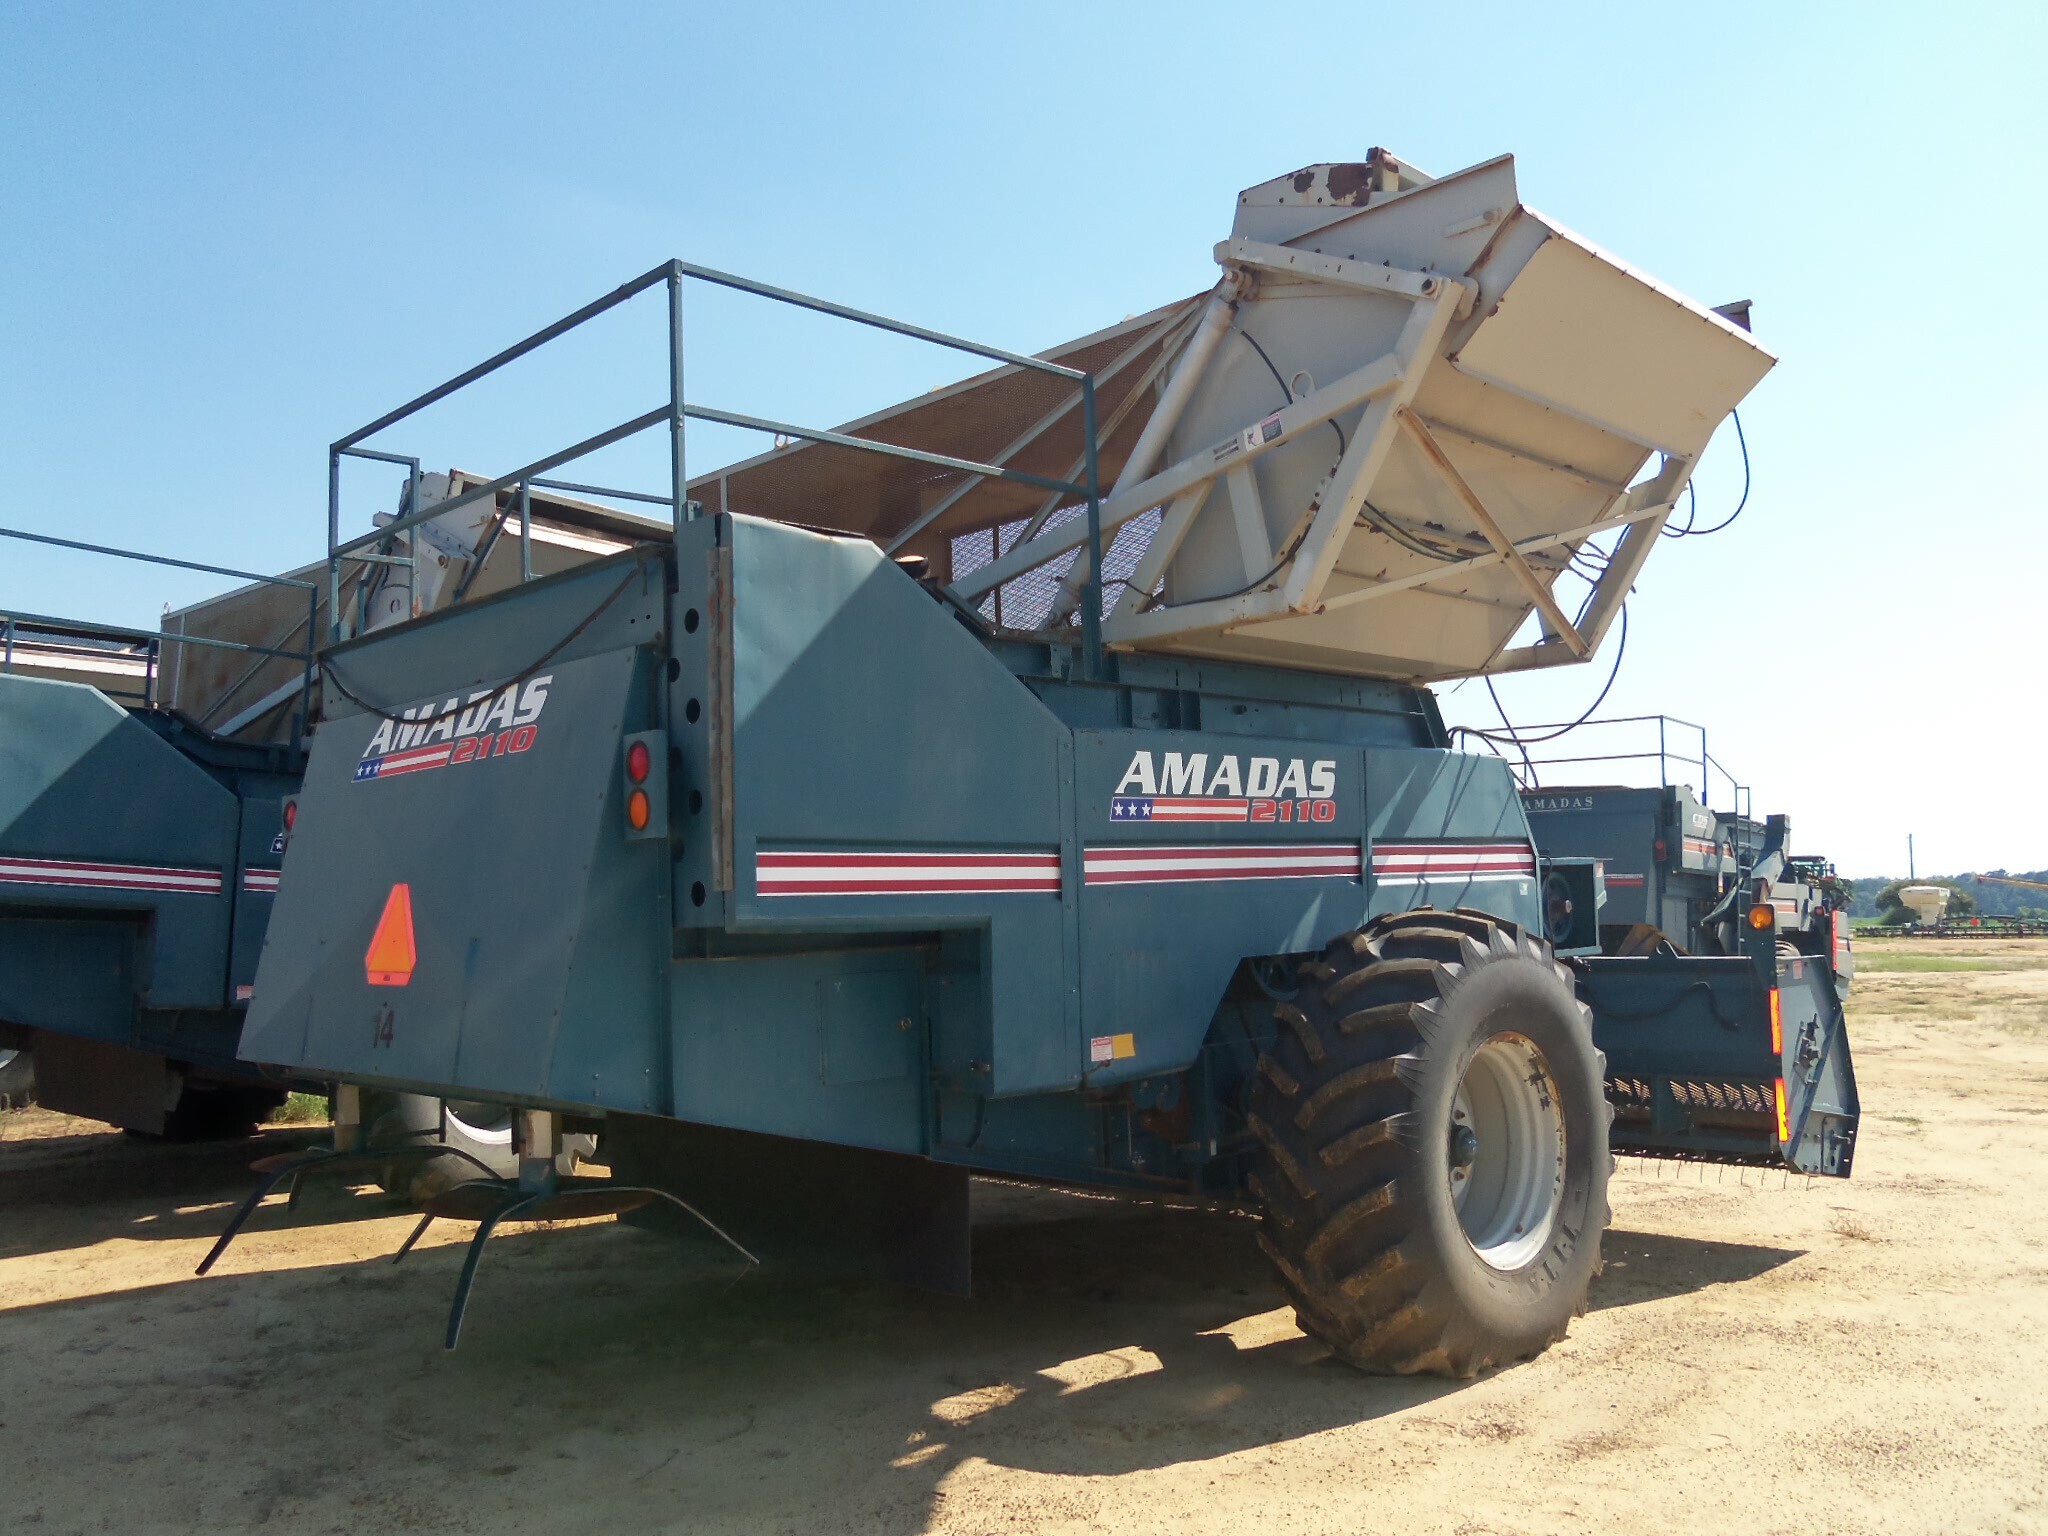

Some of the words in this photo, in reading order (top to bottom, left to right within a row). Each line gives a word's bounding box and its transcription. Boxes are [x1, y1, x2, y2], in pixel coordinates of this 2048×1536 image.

[362, 675, 553, 758] AMADAS
[450, 725, 537, 764] 2110
[1114, 750, 1336, 798] AMADAS
[1250, 799, 1336, 823] 2110
[1524, 796, 1593, 810] AMADAS
[373, 1010, 394, 1048] 14
